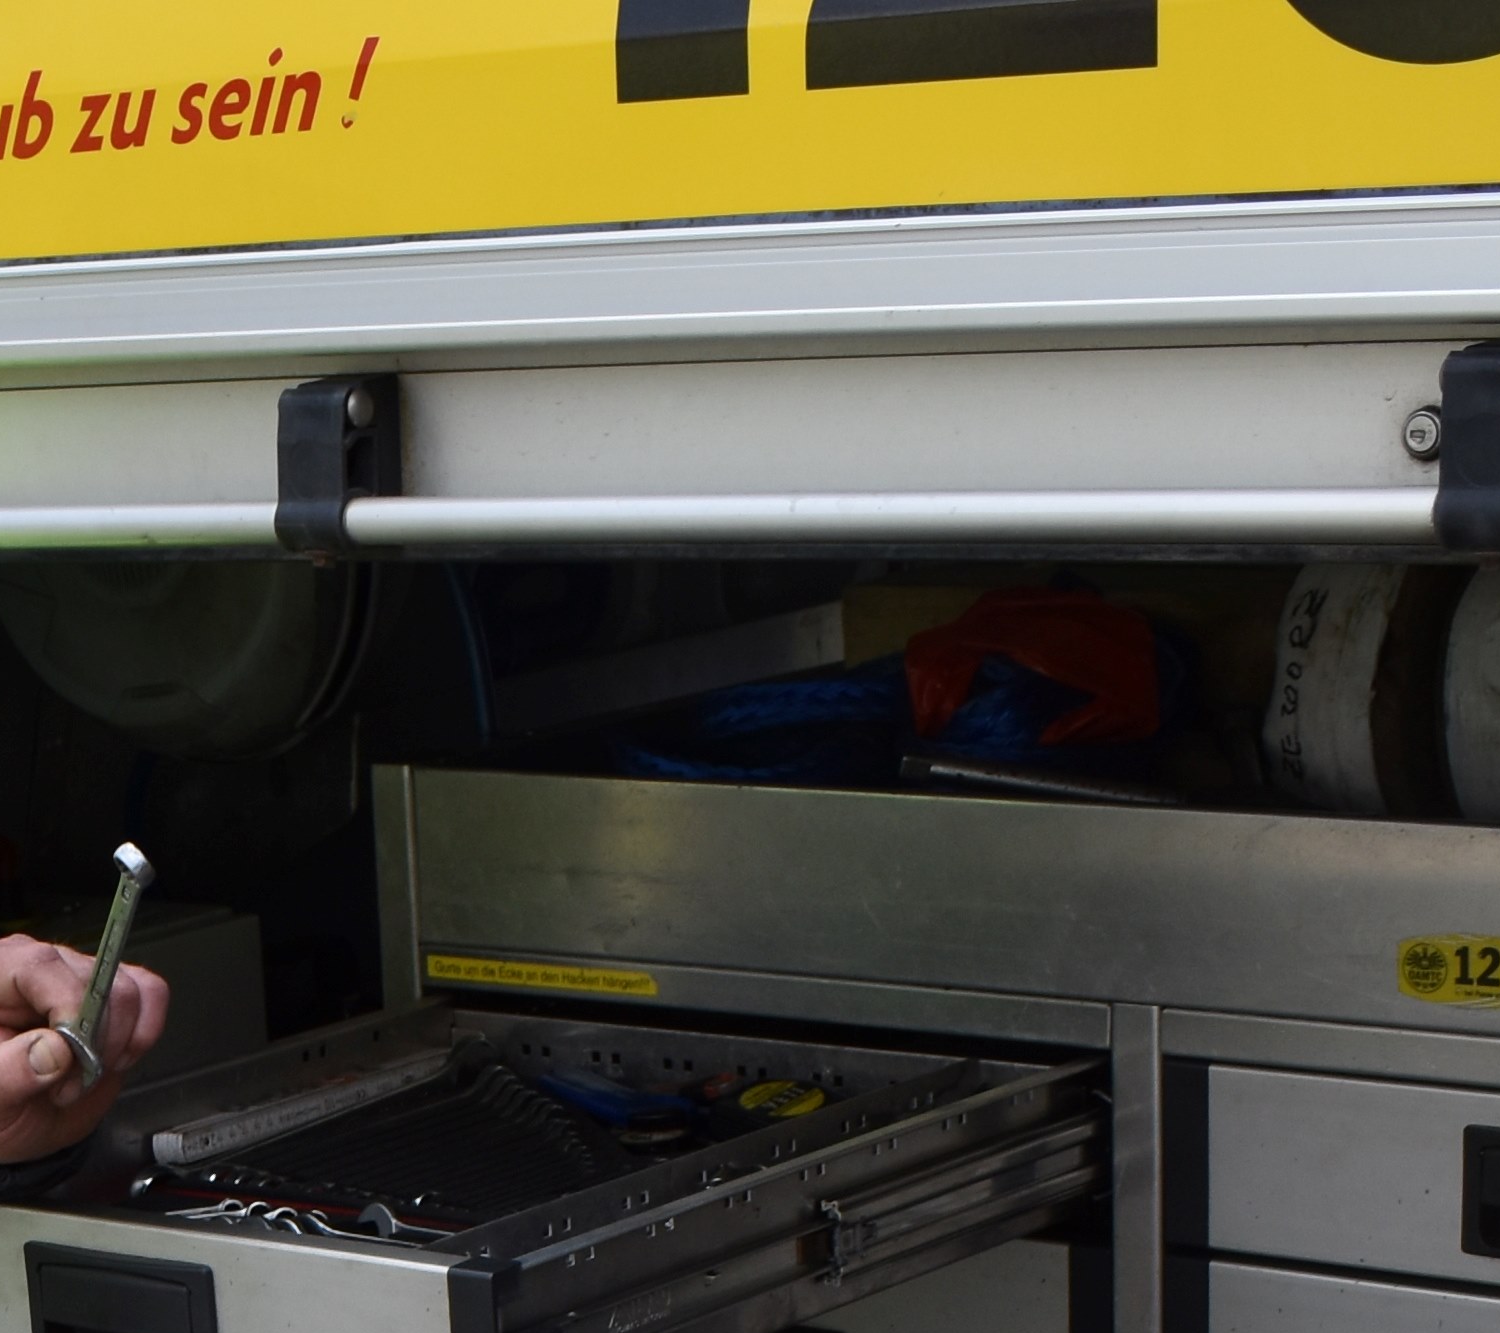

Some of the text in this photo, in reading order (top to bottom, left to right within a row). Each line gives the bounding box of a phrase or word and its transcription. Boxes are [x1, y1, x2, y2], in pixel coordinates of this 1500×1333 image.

[70, 87, 158, 155] zu
[169, 47, 324, 146] sein
[342, 35, 381, 129] !
[498, 965, 524, 979] Ecke
